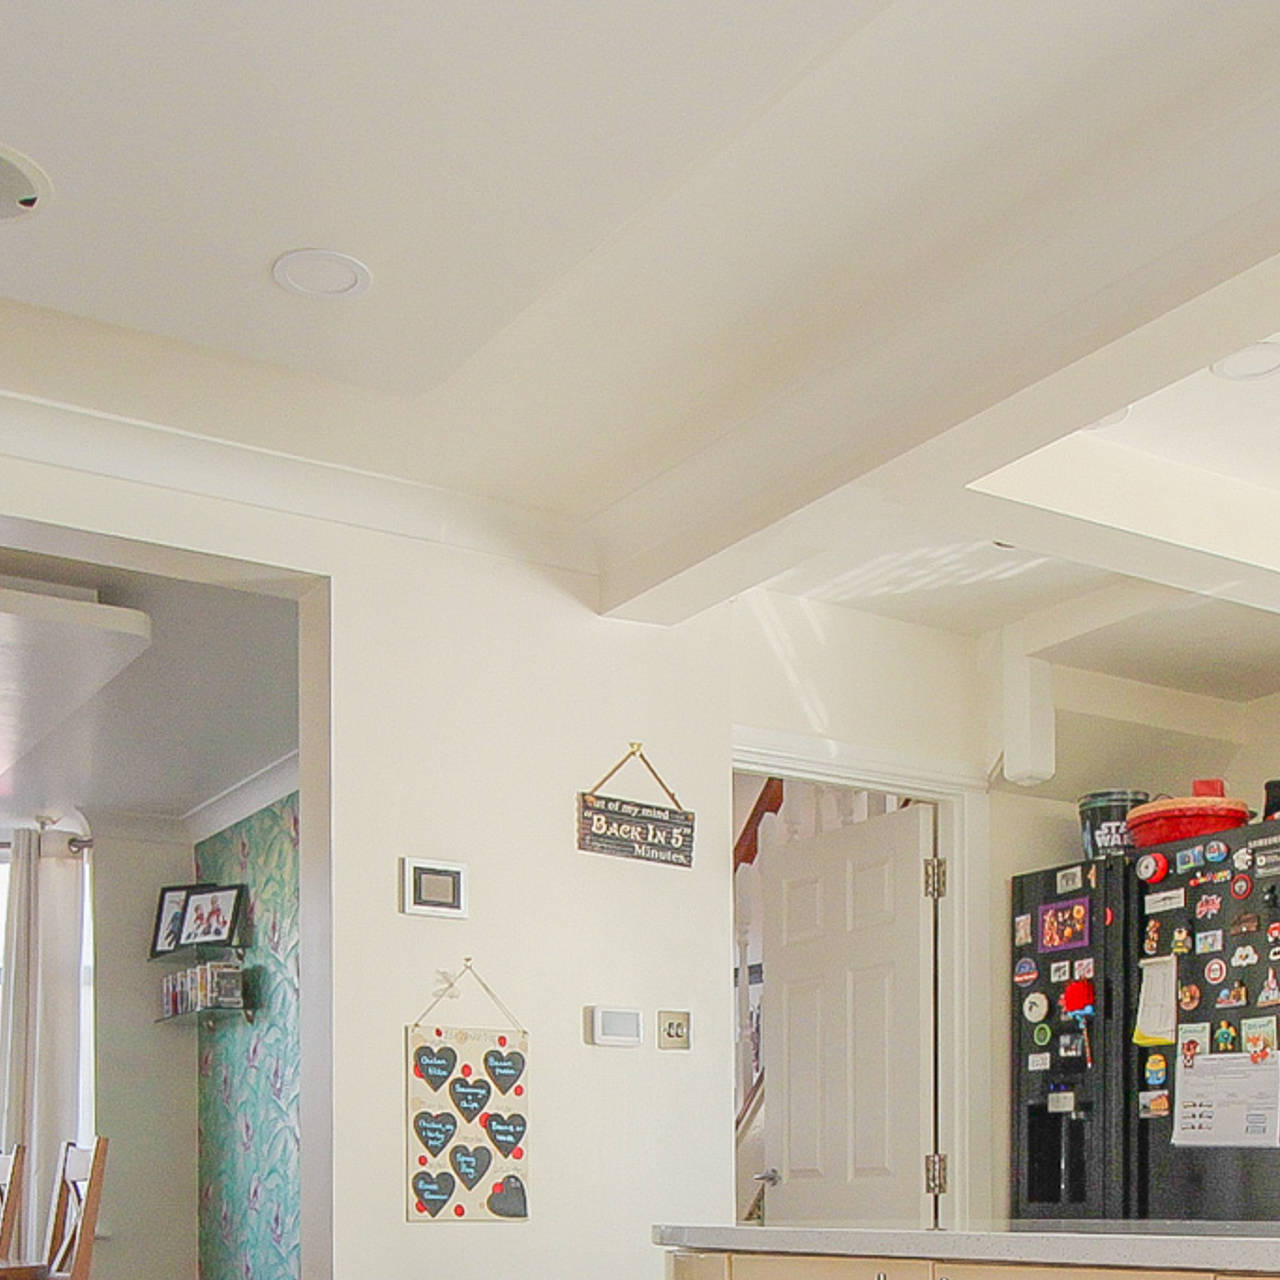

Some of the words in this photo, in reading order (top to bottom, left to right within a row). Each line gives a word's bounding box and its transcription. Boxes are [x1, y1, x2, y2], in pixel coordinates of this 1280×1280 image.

[608, 800, 619, 811] of
[622, 803, 640, 817] my
[641, 807, 670, 821] mind
